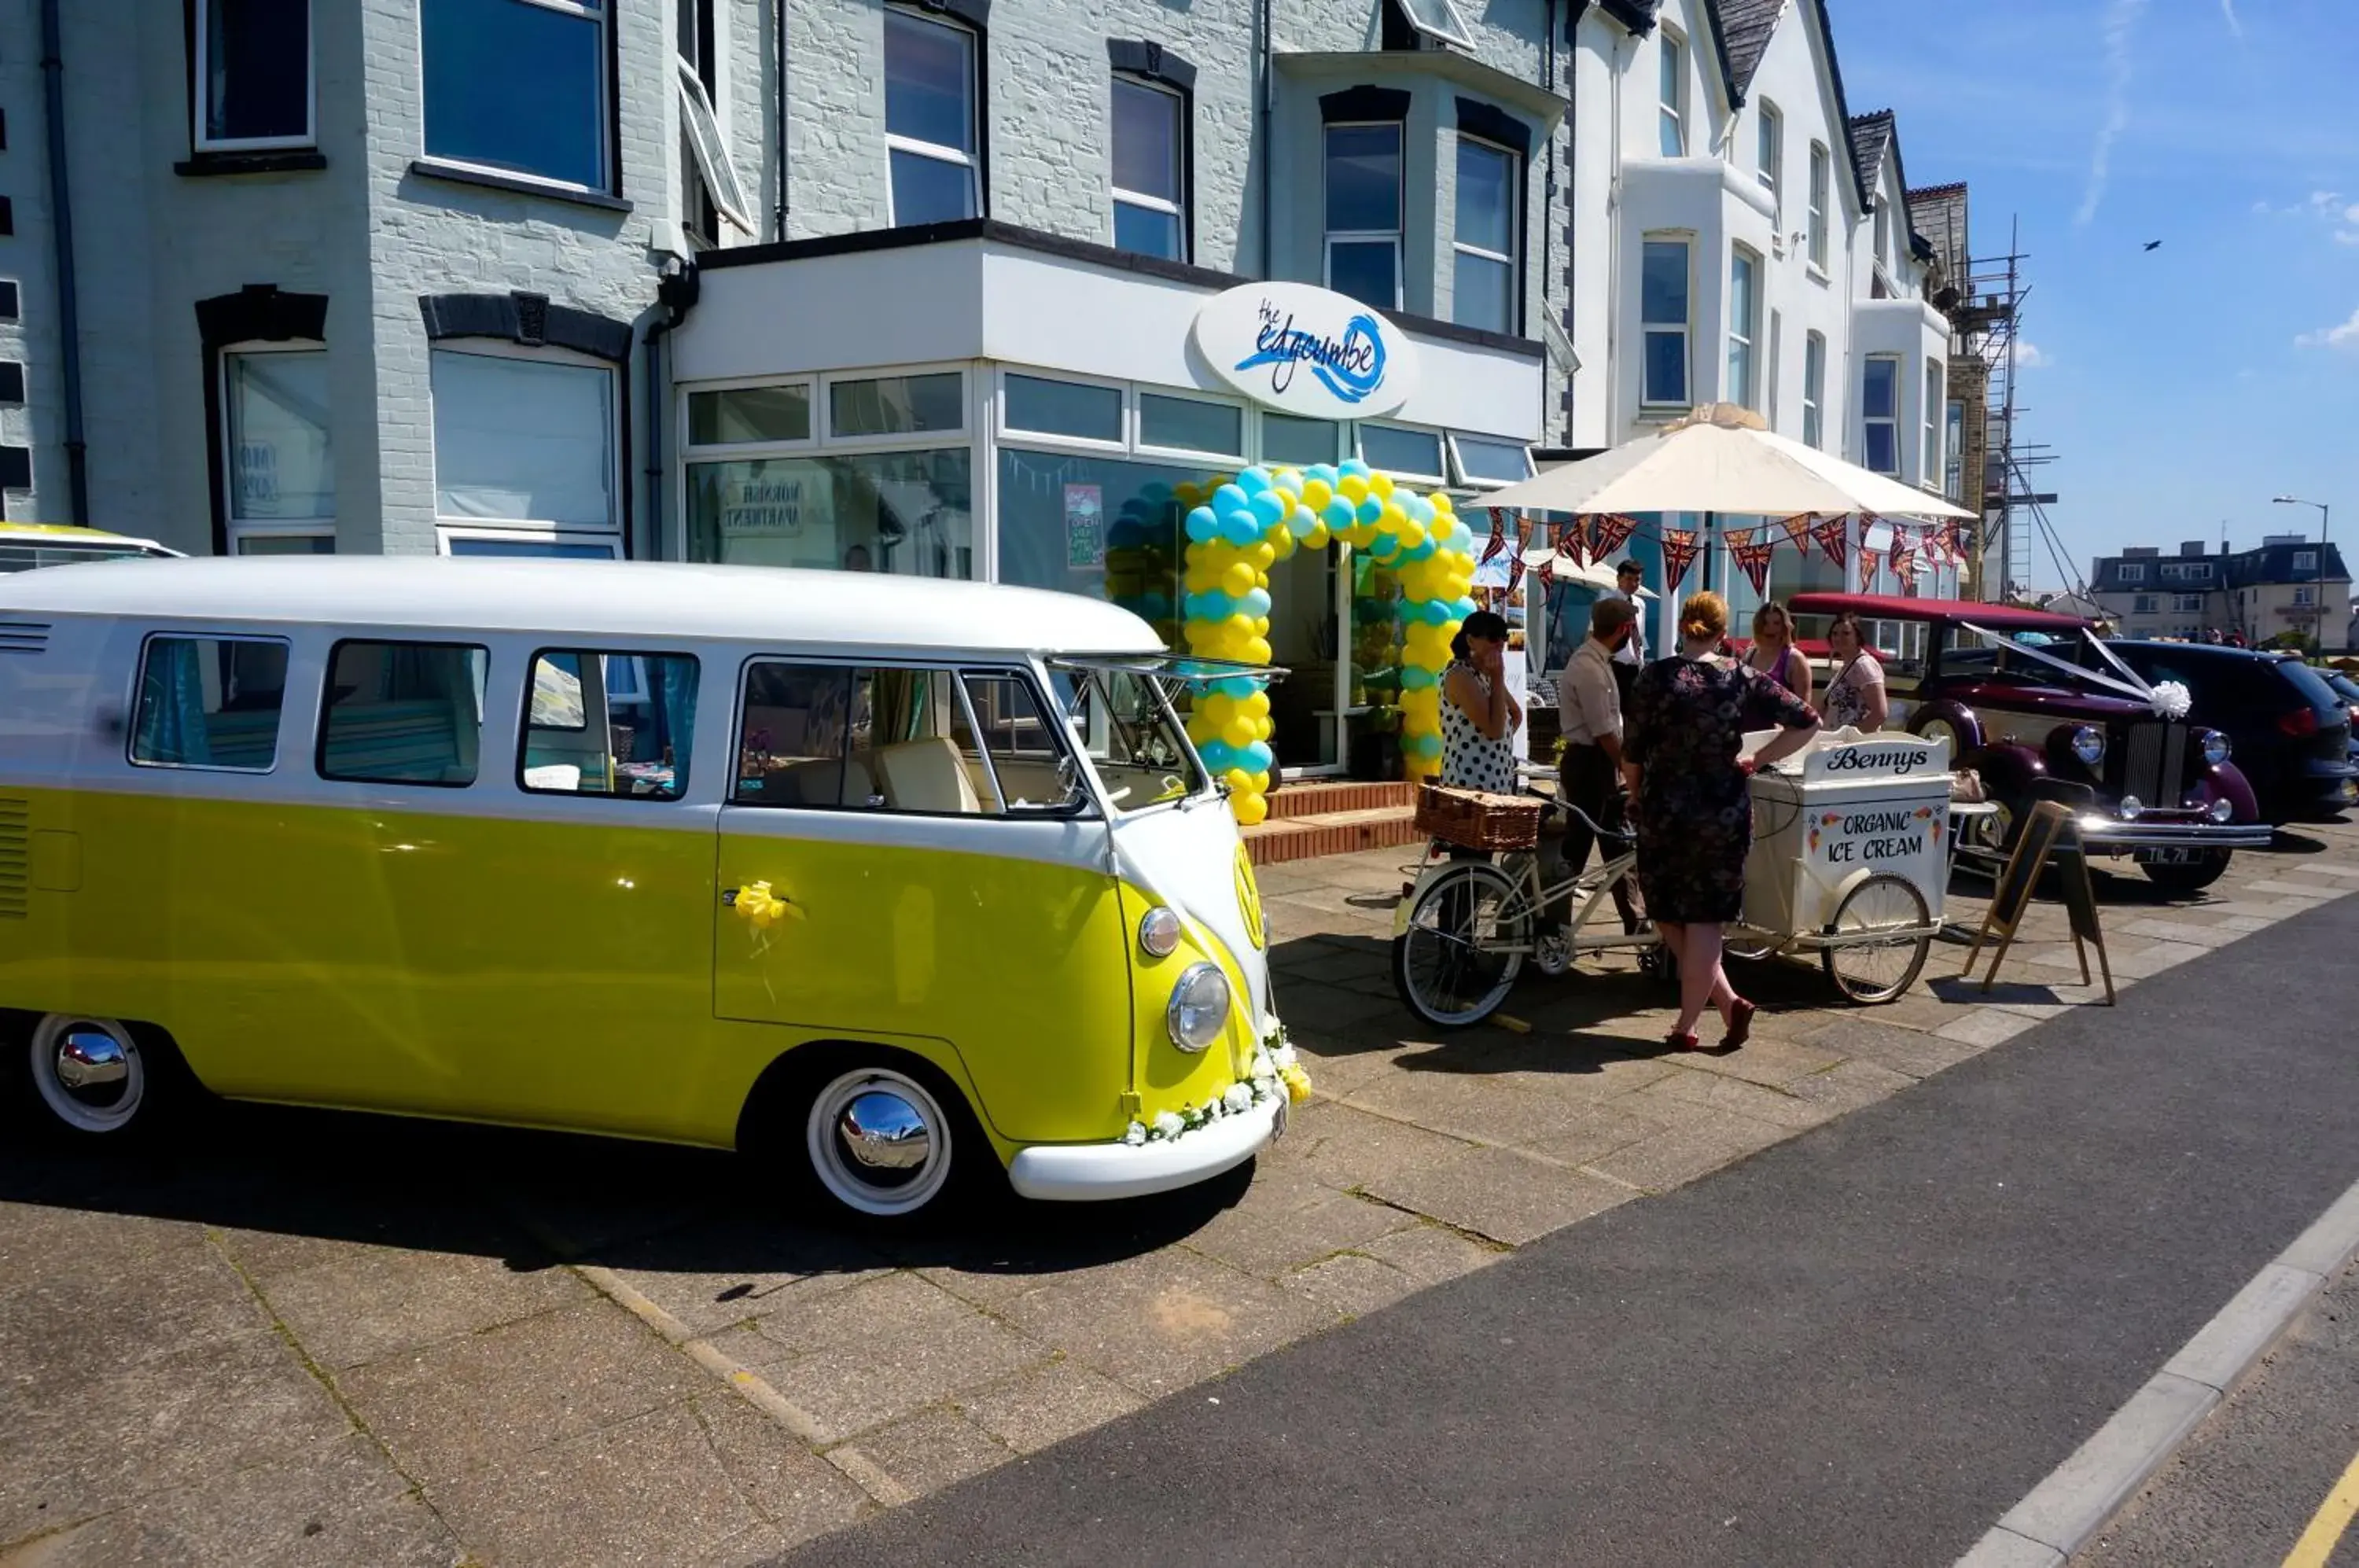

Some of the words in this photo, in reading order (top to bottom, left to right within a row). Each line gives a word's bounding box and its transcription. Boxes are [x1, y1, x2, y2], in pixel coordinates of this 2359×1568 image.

[1258, 297, 1281, 324] the
[1257, 315, 1374, 394] edgcumbe
[1827, 747, 1928, 775] Bennys
[1843, 811, 1912, 834] ORGANIC
[1827, 841, 1855, 863] ICE
[1863, 835, 1923, 860] CREAM
